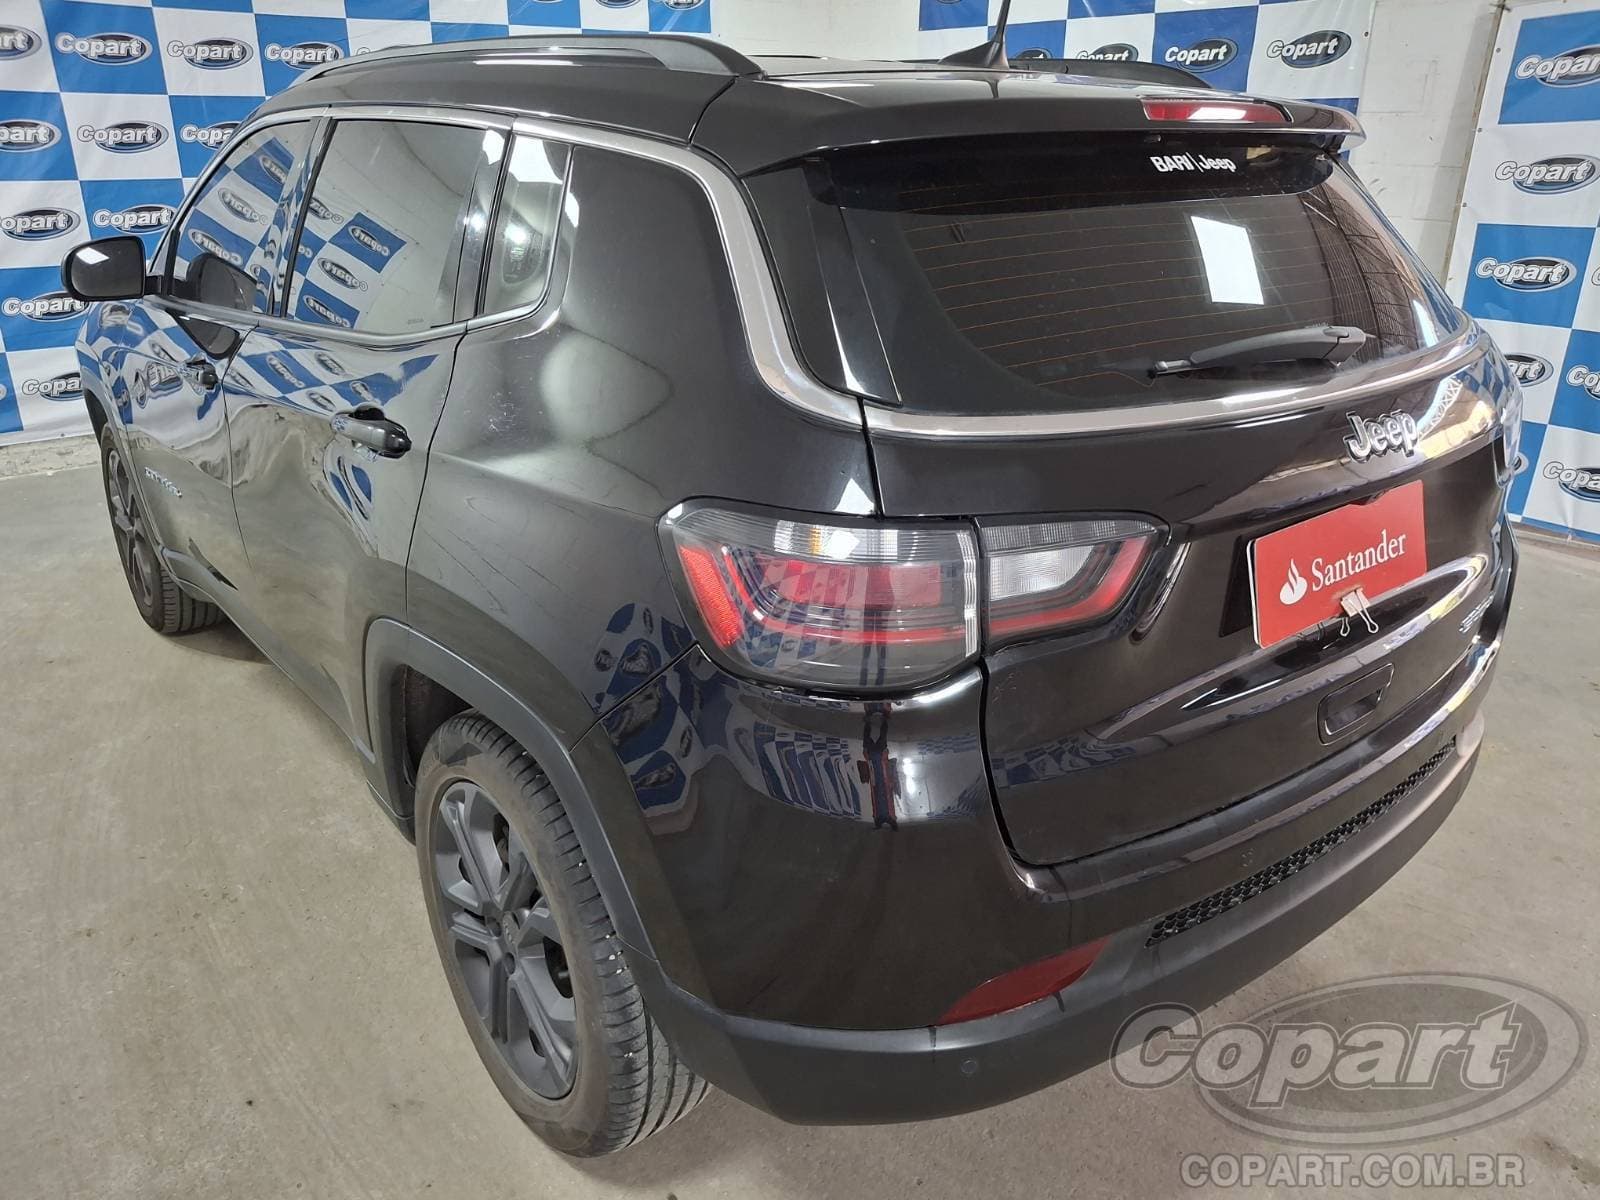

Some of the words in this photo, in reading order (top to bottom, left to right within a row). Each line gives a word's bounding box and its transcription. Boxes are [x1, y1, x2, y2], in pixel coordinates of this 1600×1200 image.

[56, 32, 142, 57] Copart
[167, 40, 243, 62] Copart
[265, 43, 334, 64] Copart
[1164, 45, 1227, 66] Copart
[1267, 38, 1339, 61] Copart
[1515, 54, 1600, 81] Copar
[0, 125, 49, 144] part
[77, 124, 158, 146] Copart
[181, 124, 234, 147] Copa
[1150, 155, 1195, 172] BARI
[1198, 154, 1237, 172] Jeep
[1495, 158, 1592, 187] Copart
[0, 211, 69, 233] opart
[93, 207, 172, 230] Copart
[1476, 257, 1569, 285] Copart
[22, 378, 82, 397] Copa
[1344, 410, 1419, 463] Jeep
[1543, 461, 1600, 489] Copa
[1311, 529, 1406, 592] Santander
